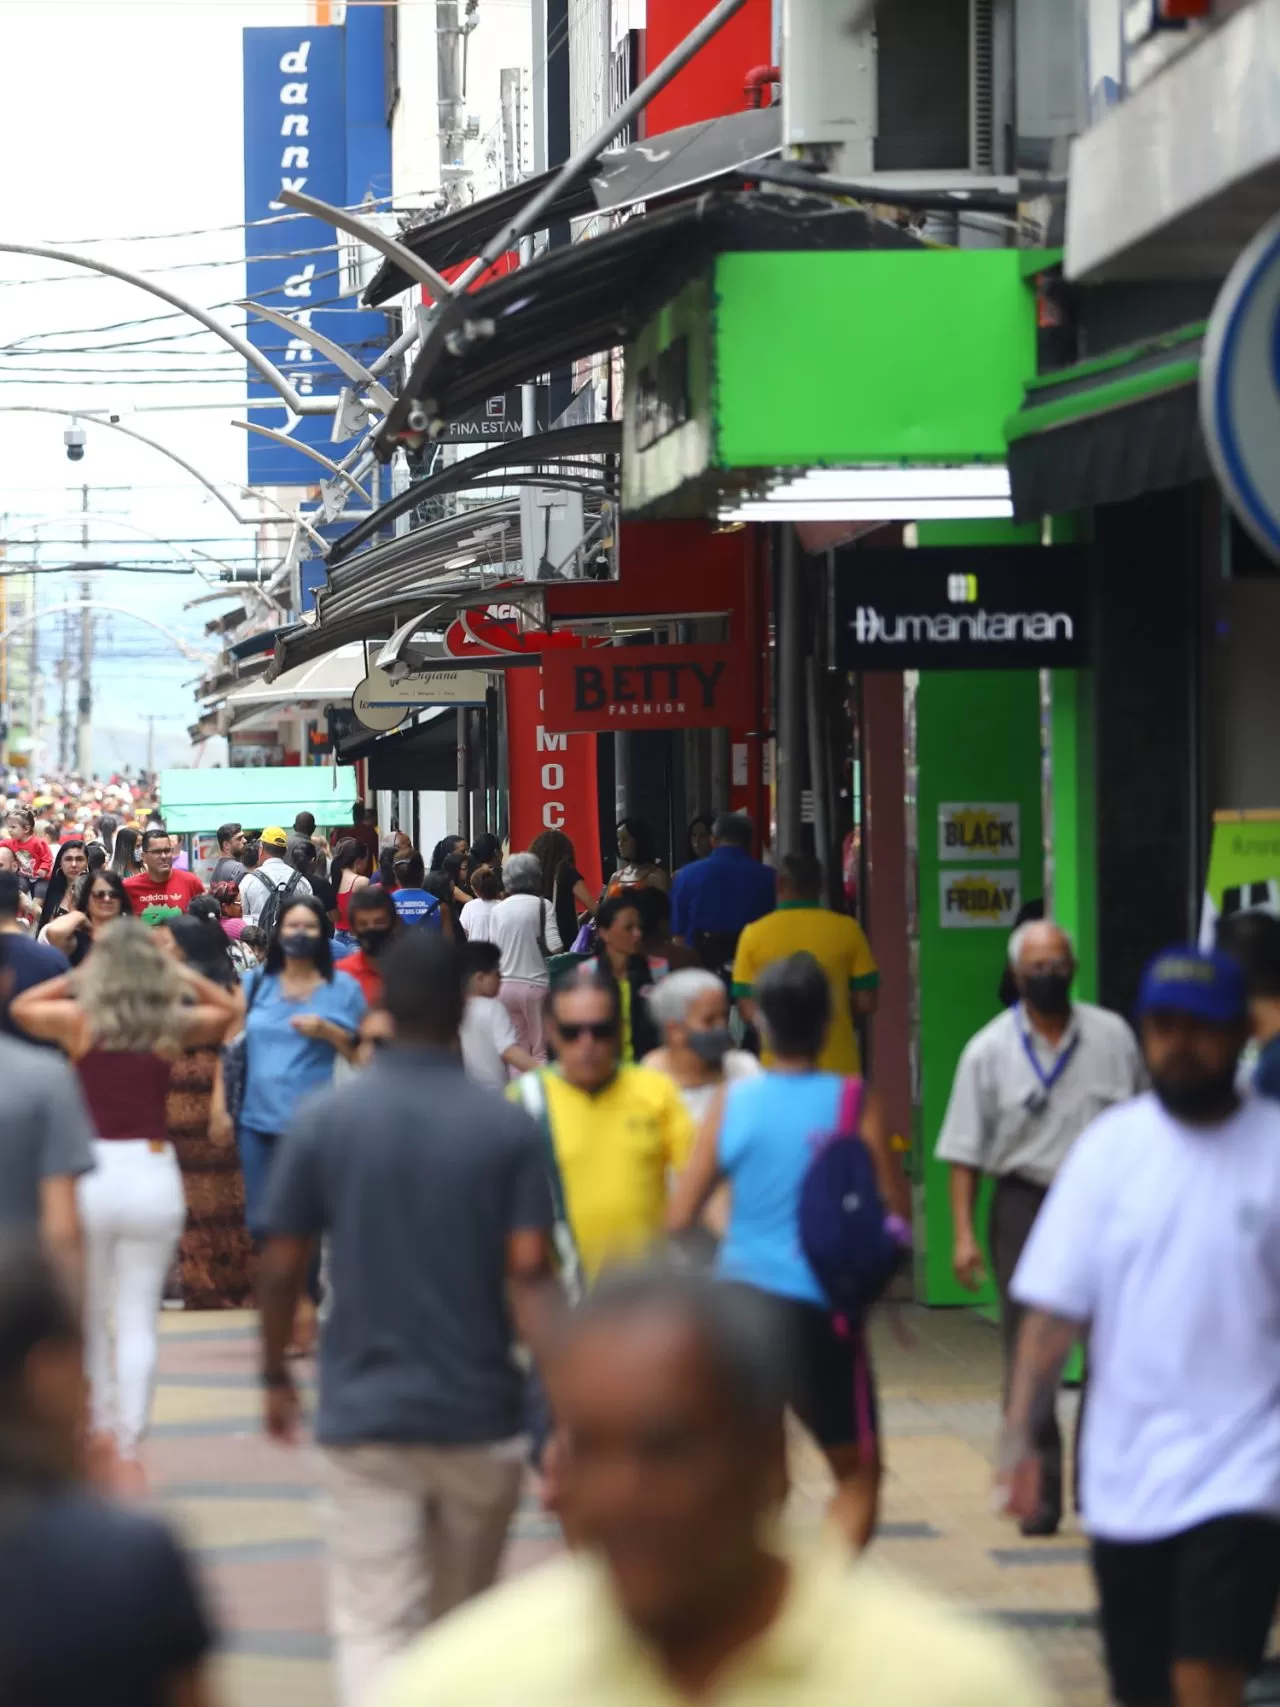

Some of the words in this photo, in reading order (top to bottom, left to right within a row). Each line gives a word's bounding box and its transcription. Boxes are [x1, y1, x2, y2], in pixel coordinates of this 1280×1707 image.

[268, 40, 312, 211] danny
[450, 422, 479, 435] FINA
[481, 420, 543, 434] ESTAM
[573, 661, 726, 713] BETTY
[608, 703, 687, 716] FASHION
[945, 820, 1015, 846] BLACK
[139, 893, 169, 902] adidas
[946, 887, 1016, 912] FRIDAY
